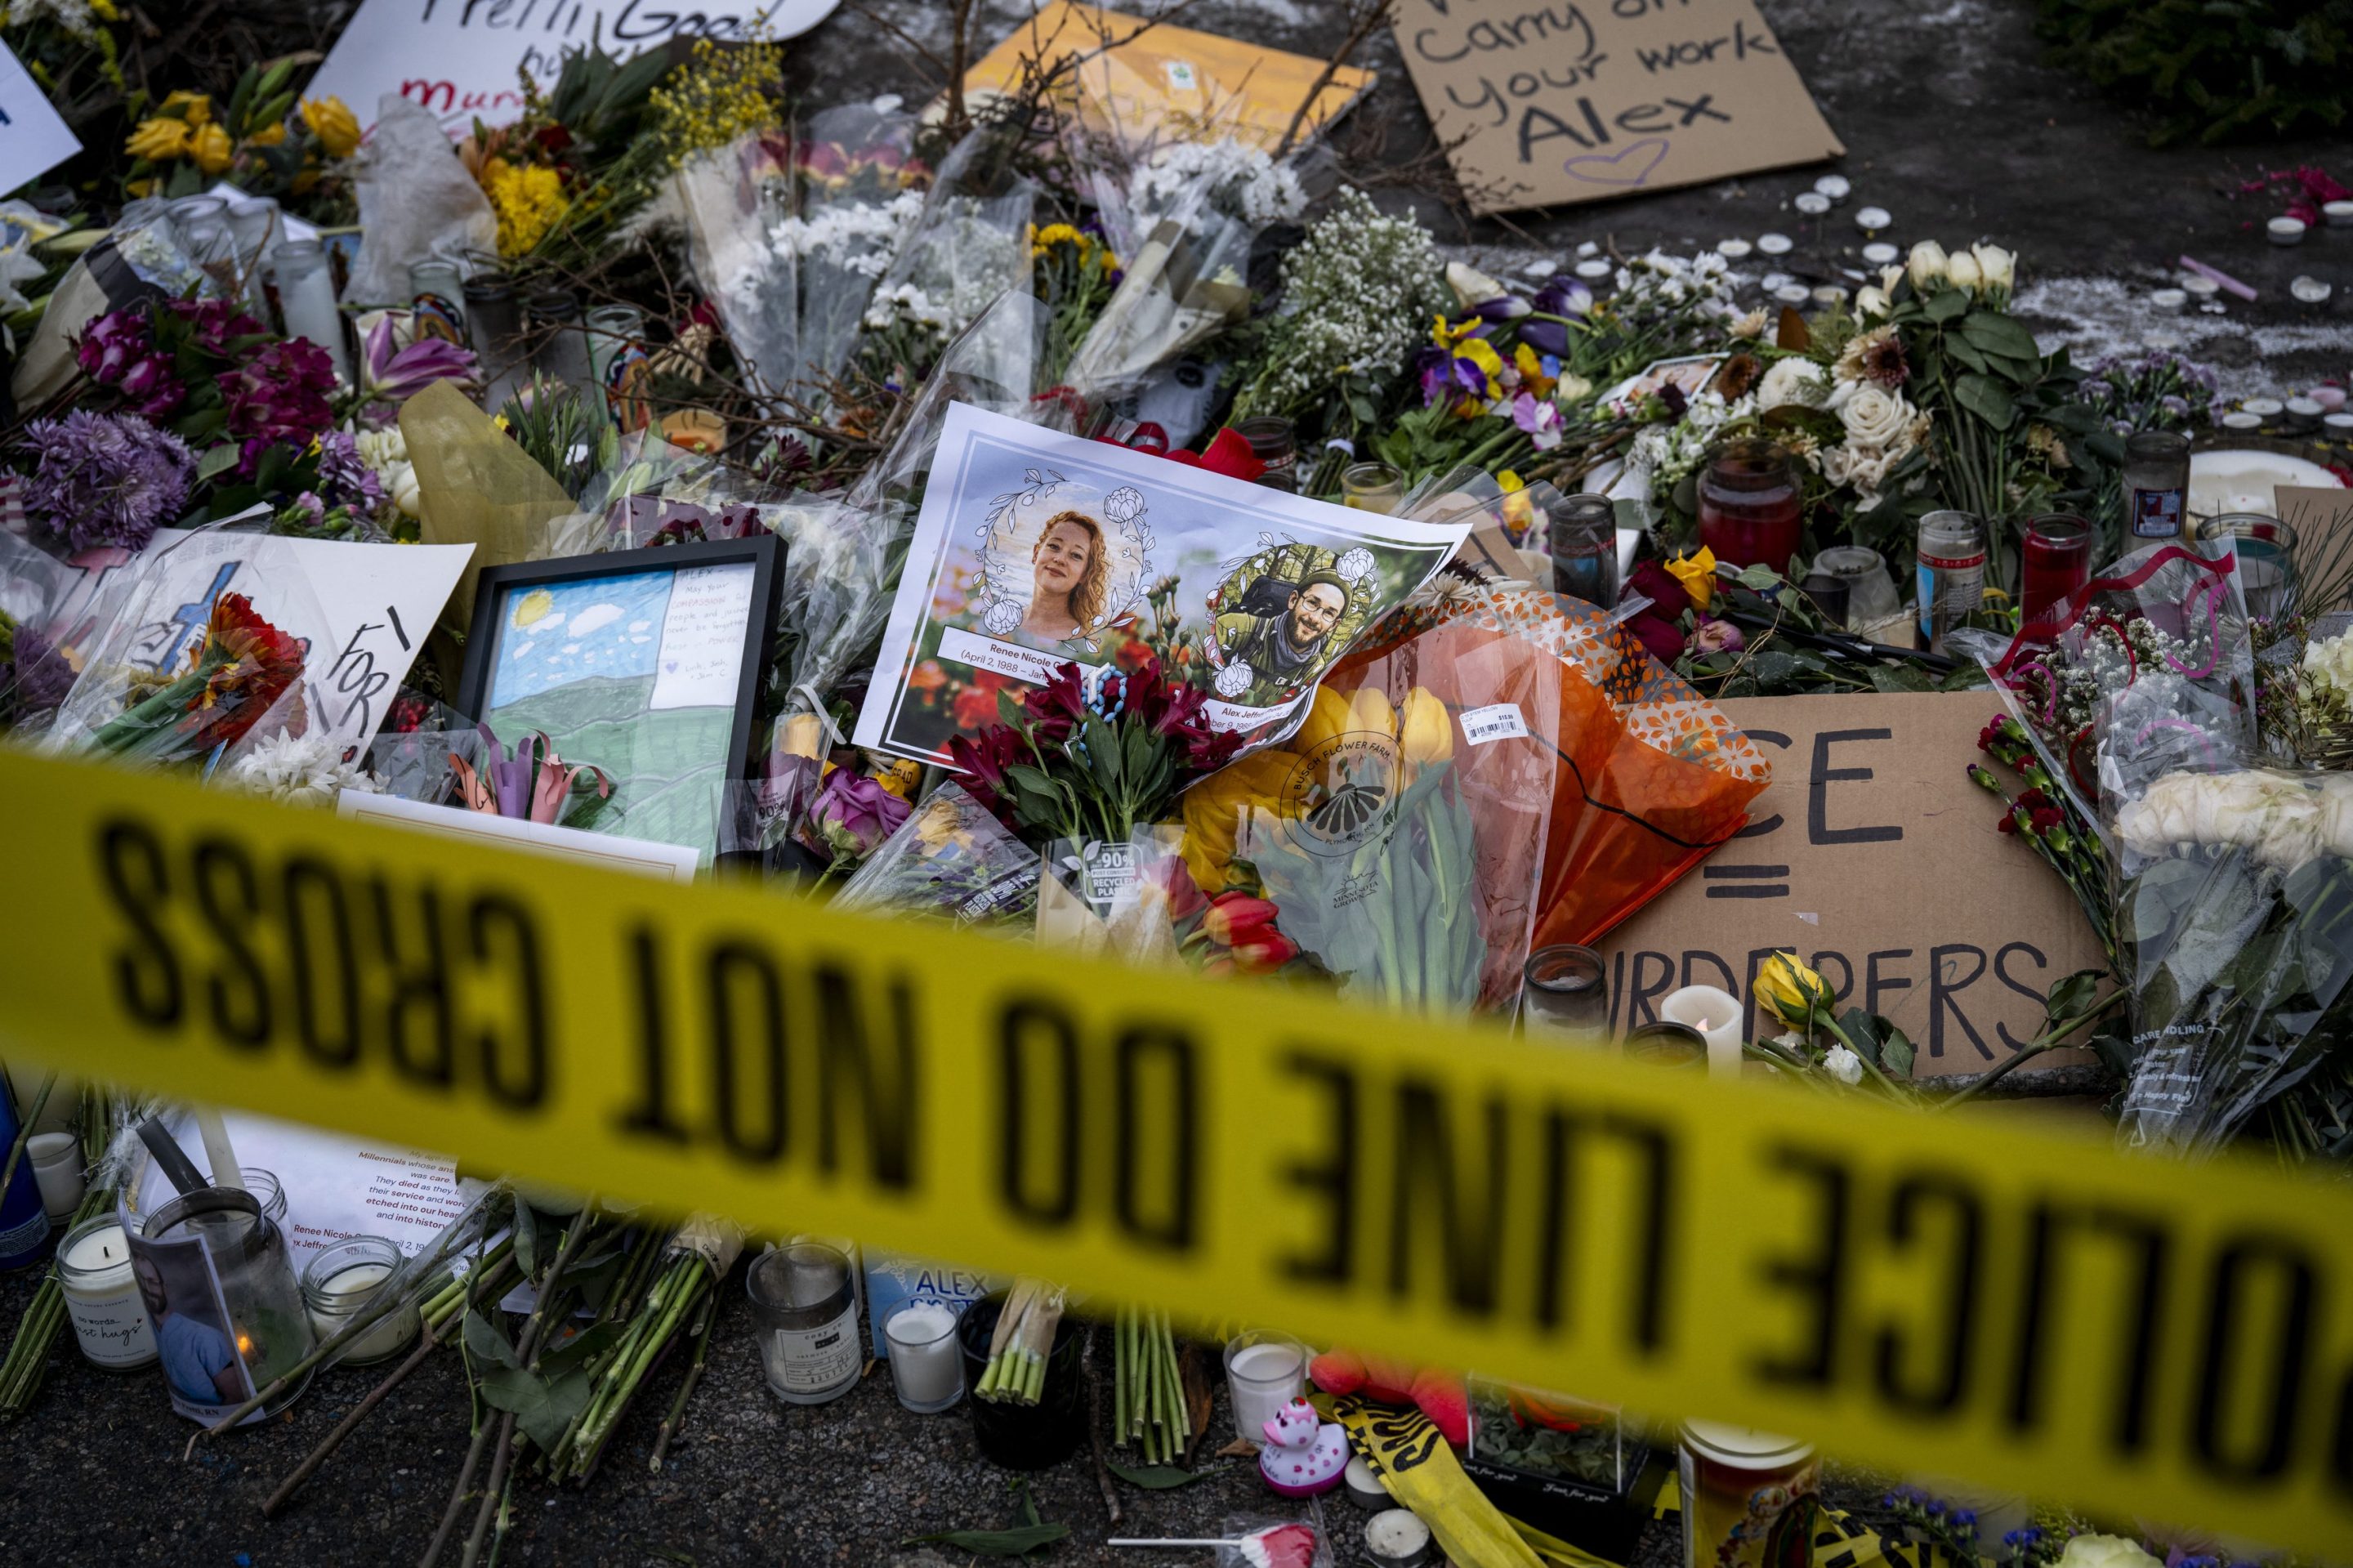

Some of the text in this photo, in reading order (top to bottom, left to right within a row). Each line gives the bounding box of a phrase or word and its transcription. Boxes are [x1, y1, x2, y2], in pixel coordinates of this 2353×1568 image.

[1445, 20, 1777, 127] your work
[1517, 93, 1732, 163] Alex
[960, 649, 985, 666] (April
[986, 657, 995, 668] 2,
[997, 660, 1019, 673] 1988
[989, 643, 1020, 661] Renee
[1021, 651, 1052, 668] Nicole
[328, 623, 389, 738] FOR
[1221, 707, 1240, 717] Alex
[1293, 741, 1391, 790] BUSCH FLOWER FARM
[1364, 823, 1374, 833] MN
[1101, 851, 1136, 868] 90%
[1092, 878, 1136, 887] RECYCLED
[2132, 1030, 2161, 1044] CARE
[92, 812, 2353, 1518] OLICE LINE DO NOT CROSS
[358, 1151, 406, 1166] Millennials
[408, 1160, 436, 1170] whose
[376, 1175, 397, 1186] They
[398, 1179, 420, 1189] died
[433, 1186, 453, 1195] they
[410, 1172, 451, 1184] was care.
[368, 1186, 391, 1195] their
[391, 1189, 425, 1201] service
[426, 1195, 444, 1204] and
[366, 1197, 400, 1209] etched
[400, 1202, 419, 1212] into
[420, 1205, 437, 1214] our
[376, 1211, 395, 1221] and
[395, 1213, 413, 1224] into
[293, 1224, 322, 1236] Renee
[324, 1228, 353, 1240] Nicole
[916, 1269, 989, 1296] ALEX
[101, 1325, 142, 1347] hugs
